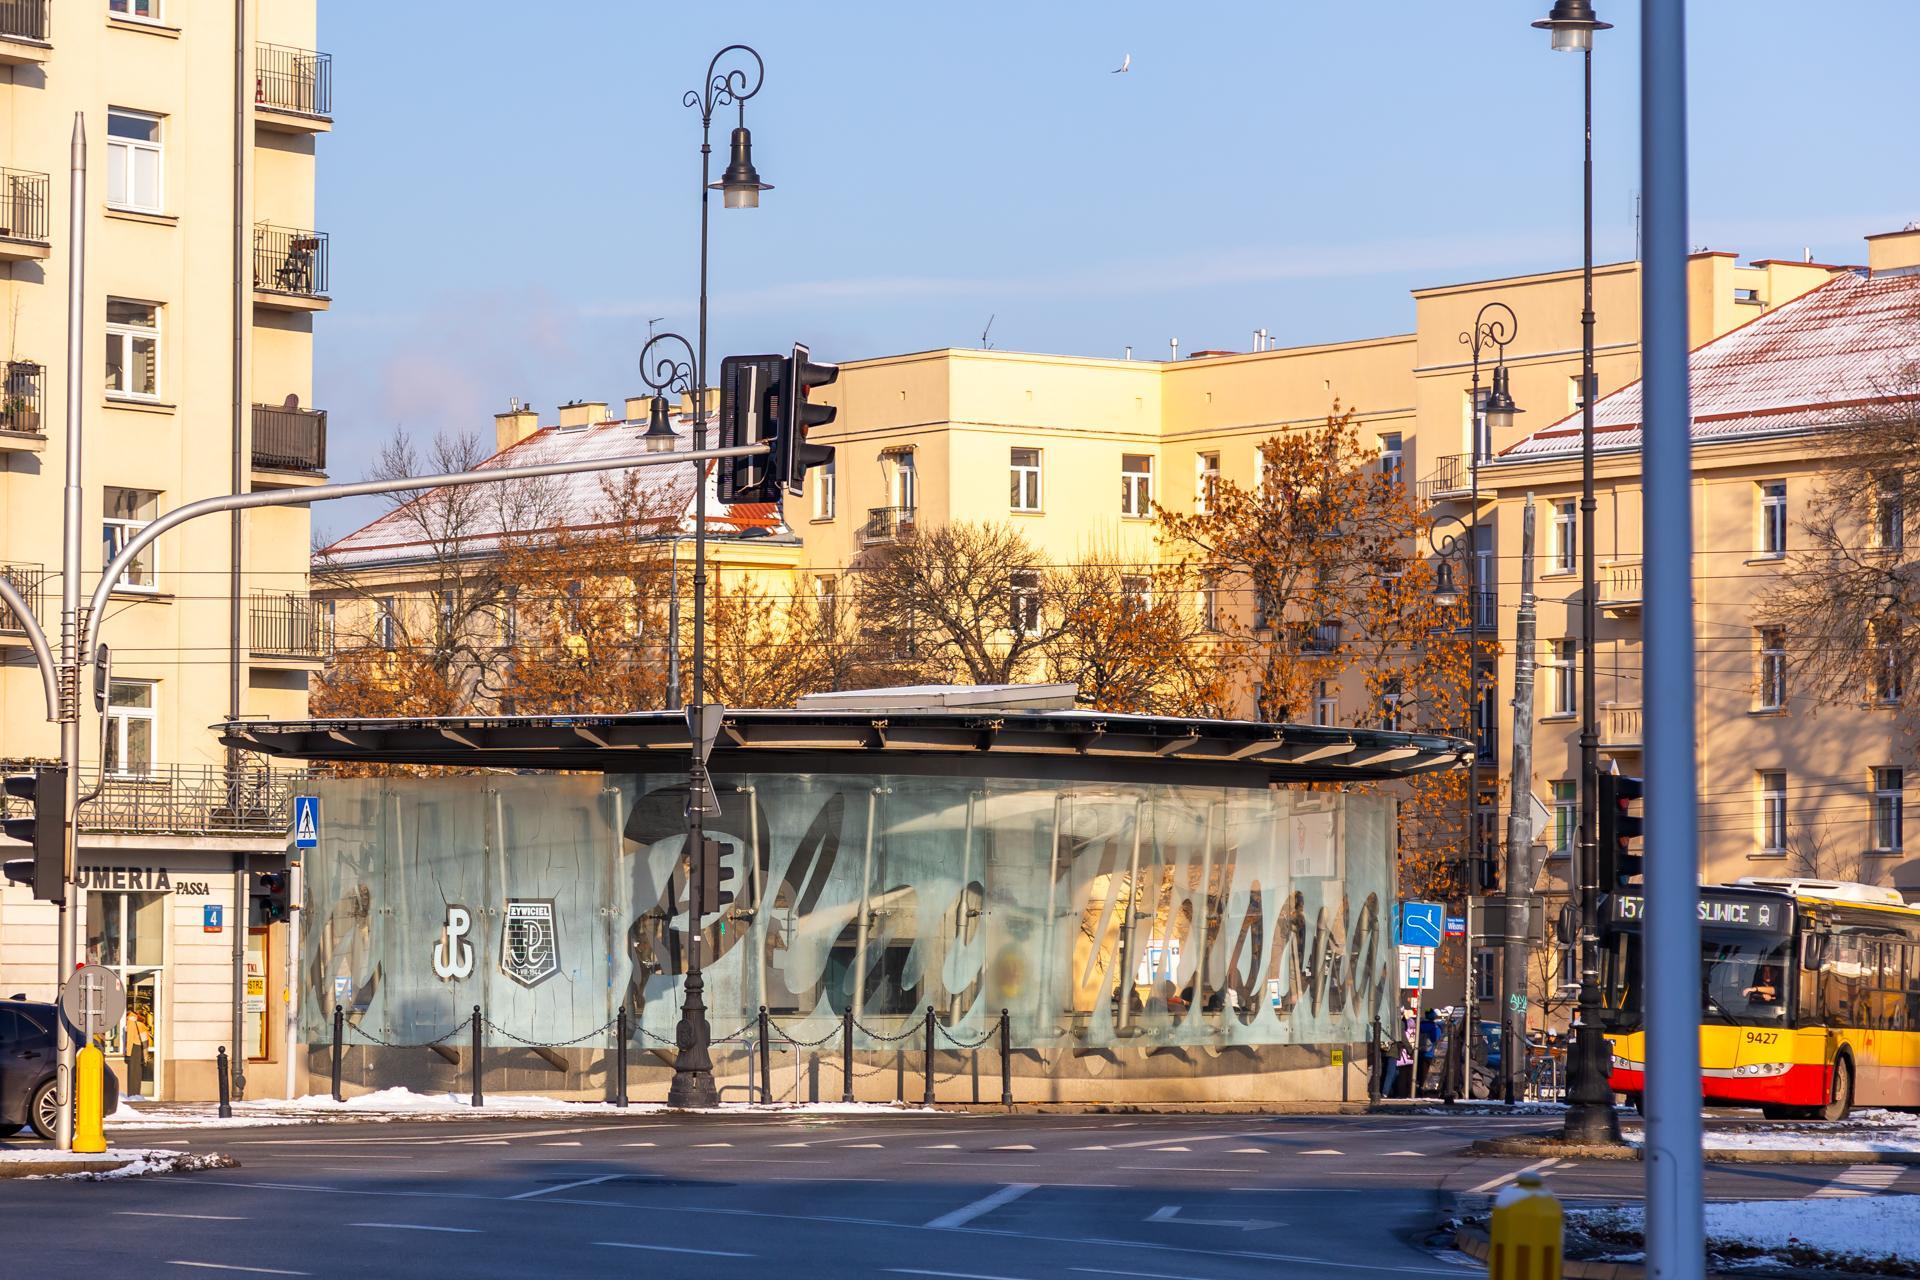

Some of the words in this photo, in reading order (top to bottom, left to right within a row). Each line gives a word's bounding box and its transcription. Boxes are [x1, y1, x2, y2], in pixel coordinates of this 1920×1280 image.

[175, 881, 210, 896] PASSA
[1618, 896, 1645, 919] 157
[210, 911, 218, 926] 4
[1746, 1031, 1779, 1045] 9427
